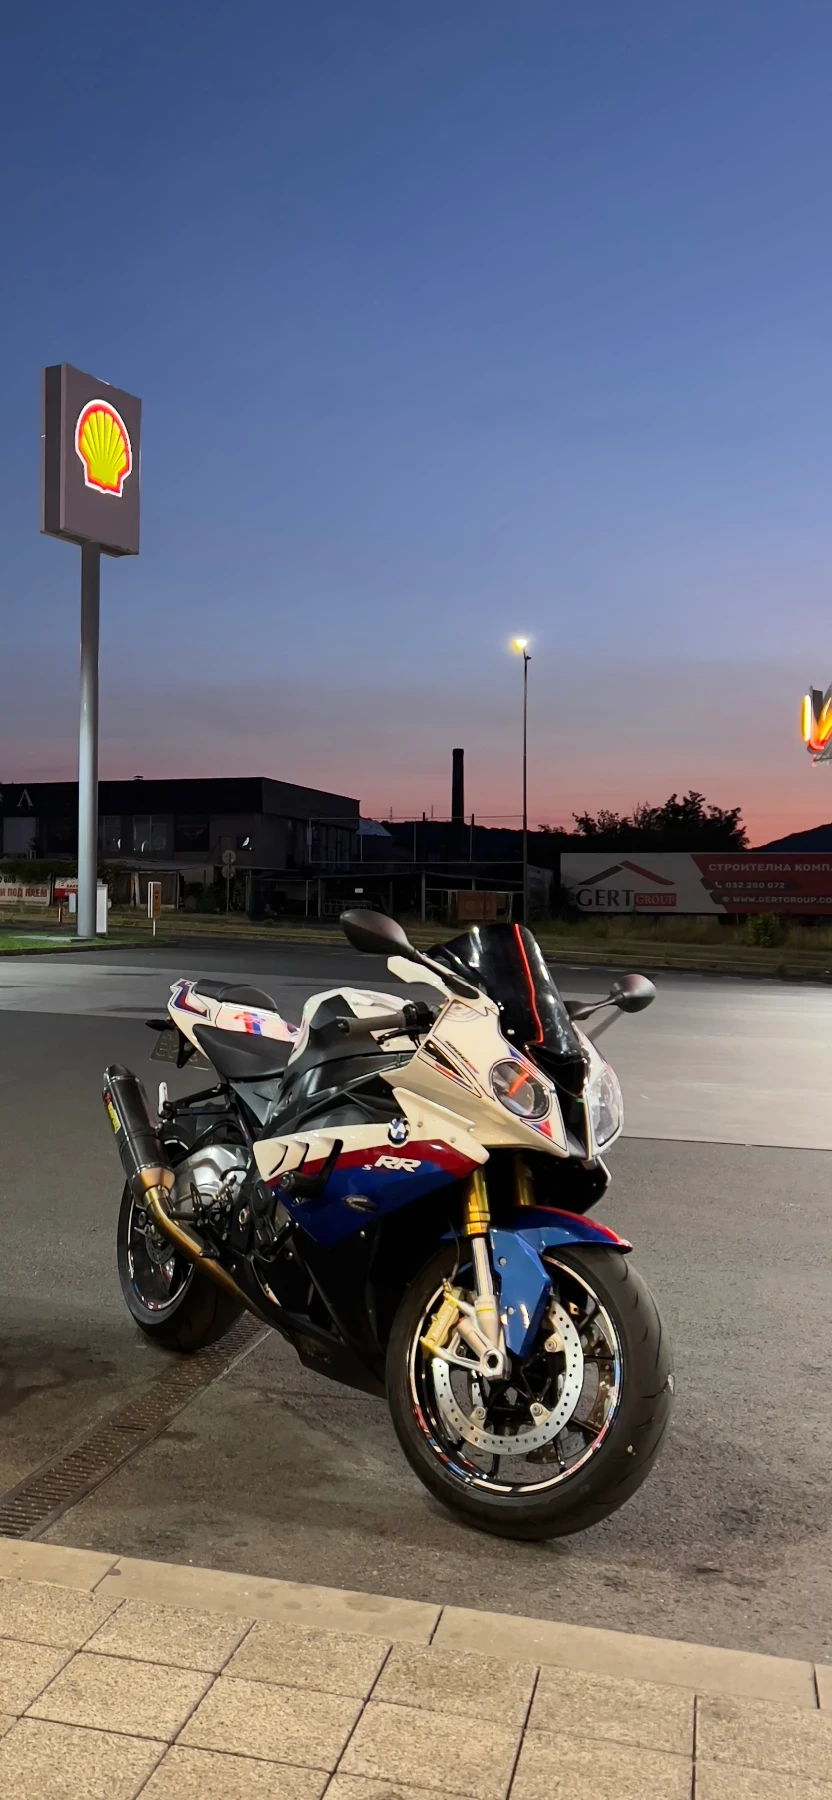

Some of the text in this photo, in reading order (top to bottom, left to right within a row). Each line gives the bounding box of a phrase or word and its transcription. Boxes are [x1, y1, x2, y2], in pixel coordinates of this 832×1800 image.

[708, 863, 832, 872] СТРОИТЕЛНА КОМП
[7, 888, 24, 898] ПОД
[576, 889, 676, 907] GERT GROUP
[374, 1155, 422, 1173] RR
